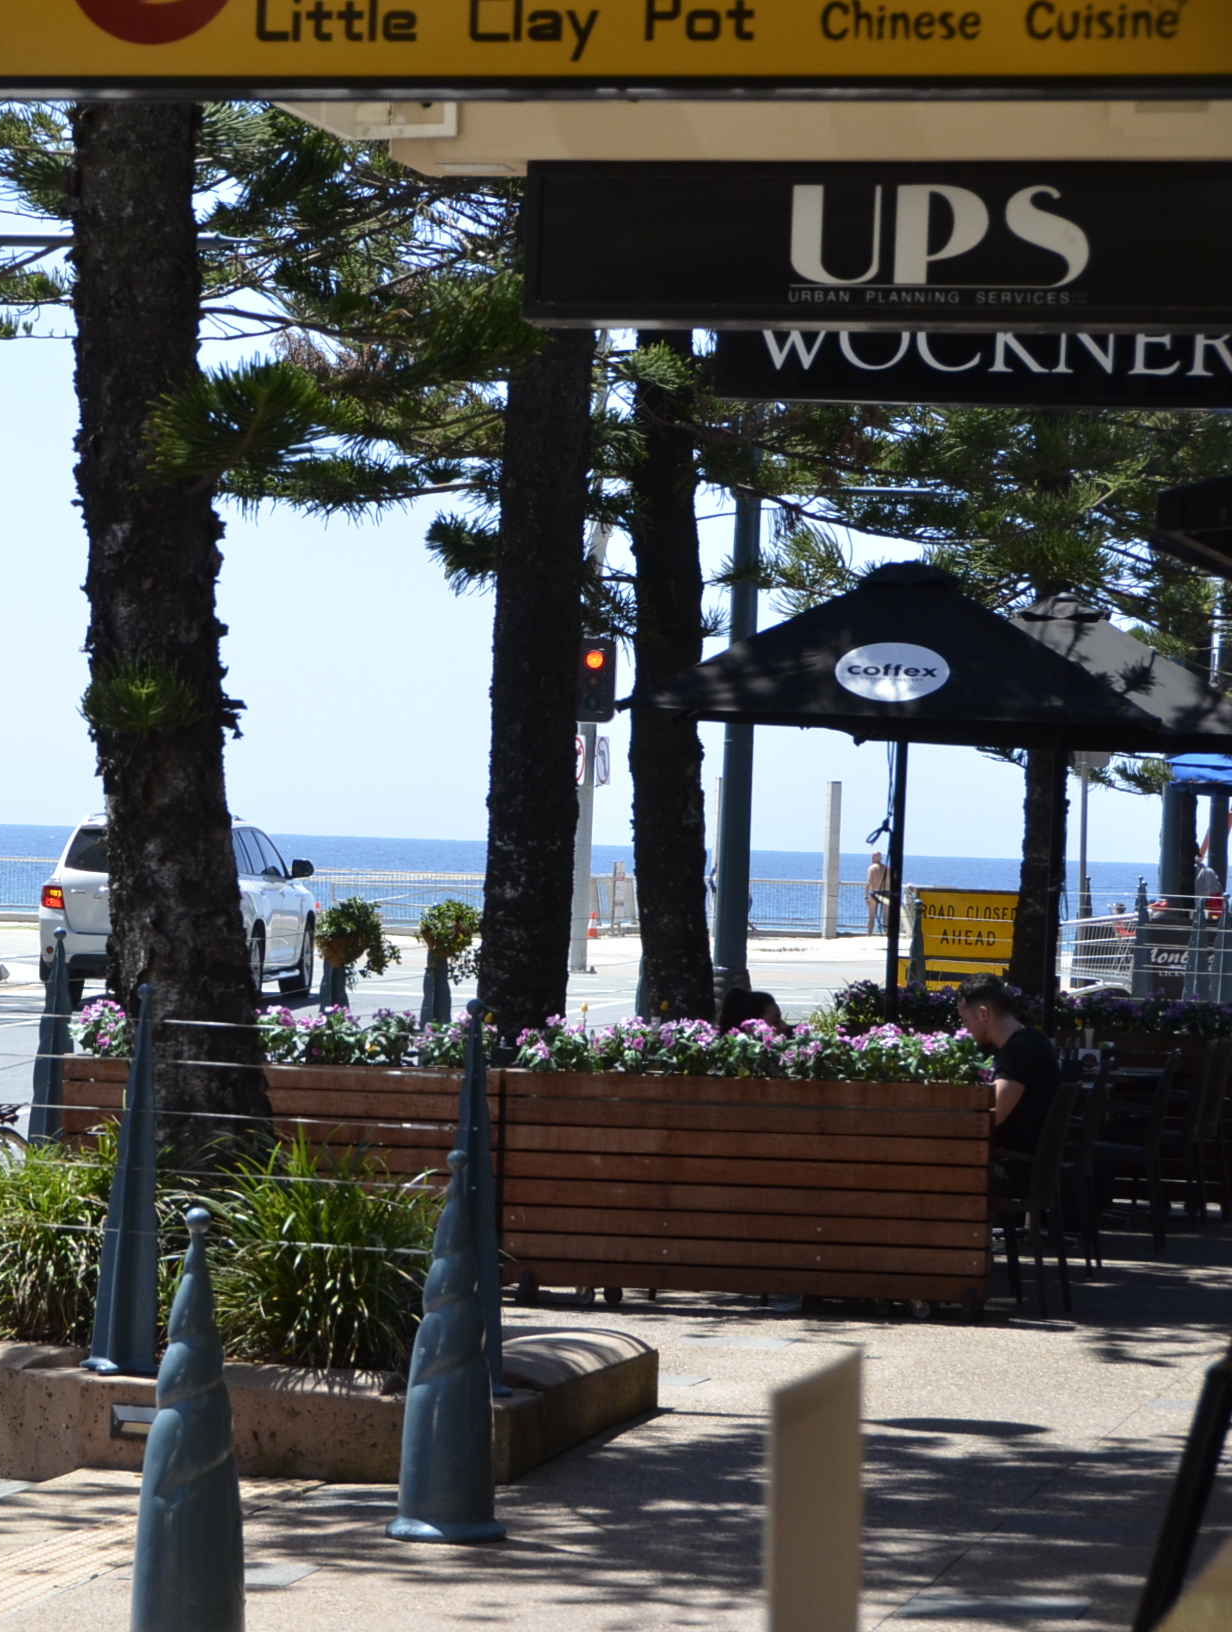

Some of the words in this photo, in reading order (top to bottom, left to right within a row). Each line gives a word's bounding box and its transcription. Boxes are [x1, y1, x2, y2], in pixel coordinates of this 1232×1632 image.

[255, 0, 417, 42] Little
[469, 0, 598, 62] Clay
[645, 0, 756, 42] Pot
[821, 1, 982, 41] Chinese
[1026, 1, 1180, 42] Cuisine
[789, 184, 1090, 288] UPS
[789, 290, 850, 303] URBAN
[867, 290, 960, 304] PLANNING
[976, 291, 1070, 305] SERVICES
[847, 663, 938, 677] coffex
[921, 904, 956, 920] ROAD
[966, 906, 1018, 922] CLOSED
[940, 929, 997, 946] AHEAD
